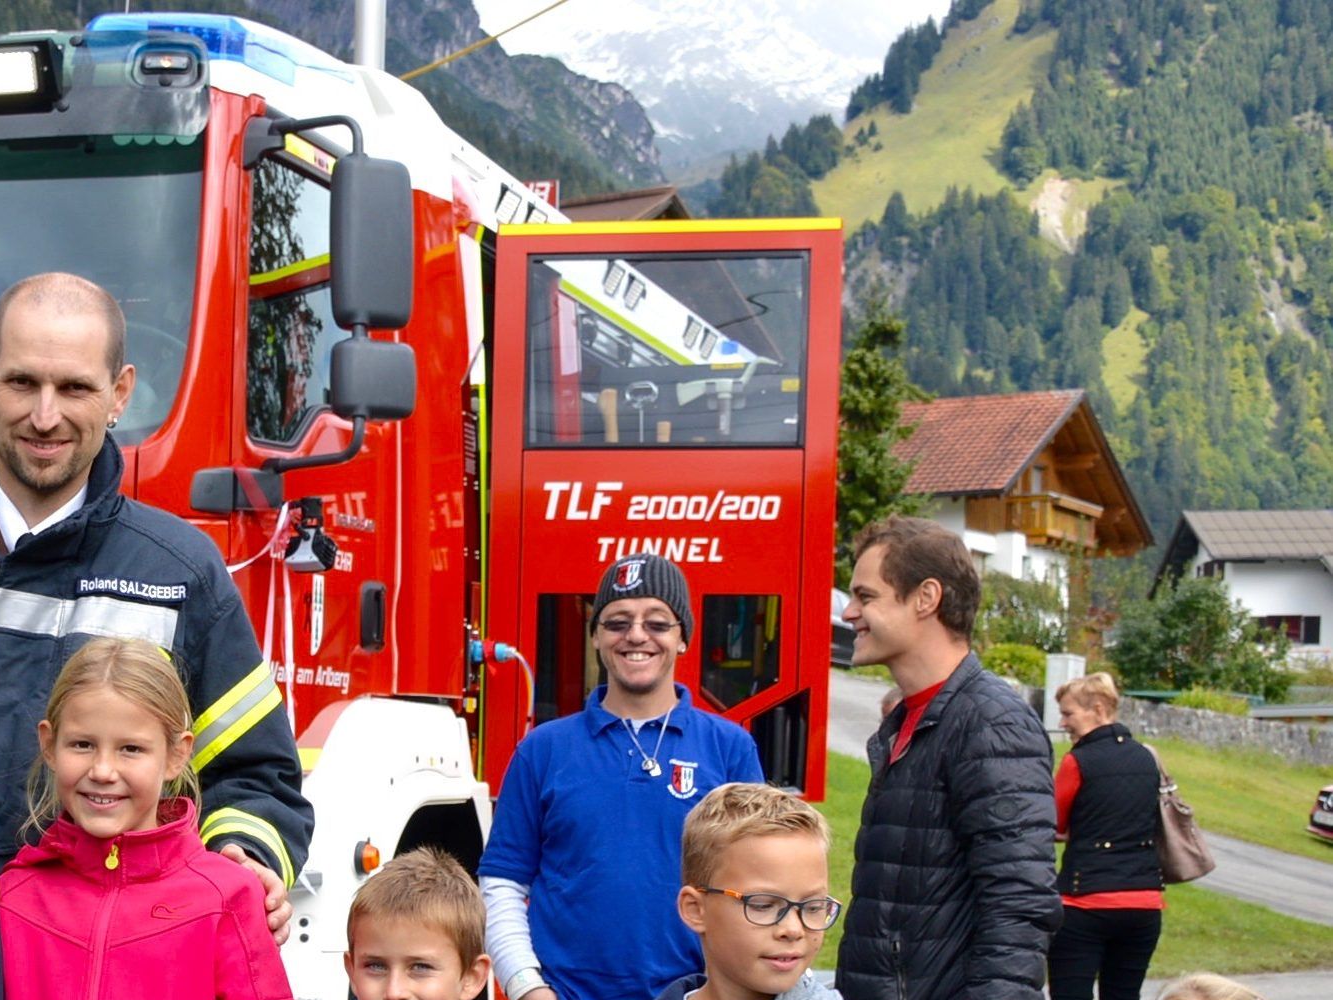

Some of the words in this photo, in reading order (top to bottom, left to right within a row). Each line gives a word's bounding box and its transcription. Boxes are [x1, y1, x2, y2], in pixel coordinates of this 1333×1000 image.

[543, 481, 623, 520] TLF
[626, 490, 782, 522] 2000/200
[597, 537, 724, 563] TUNNEL
[80, 577, 117, 592] Roland
[119, 580, 186, 599] SALZGEBER
[315, 664, 350, 695] Arlberg
